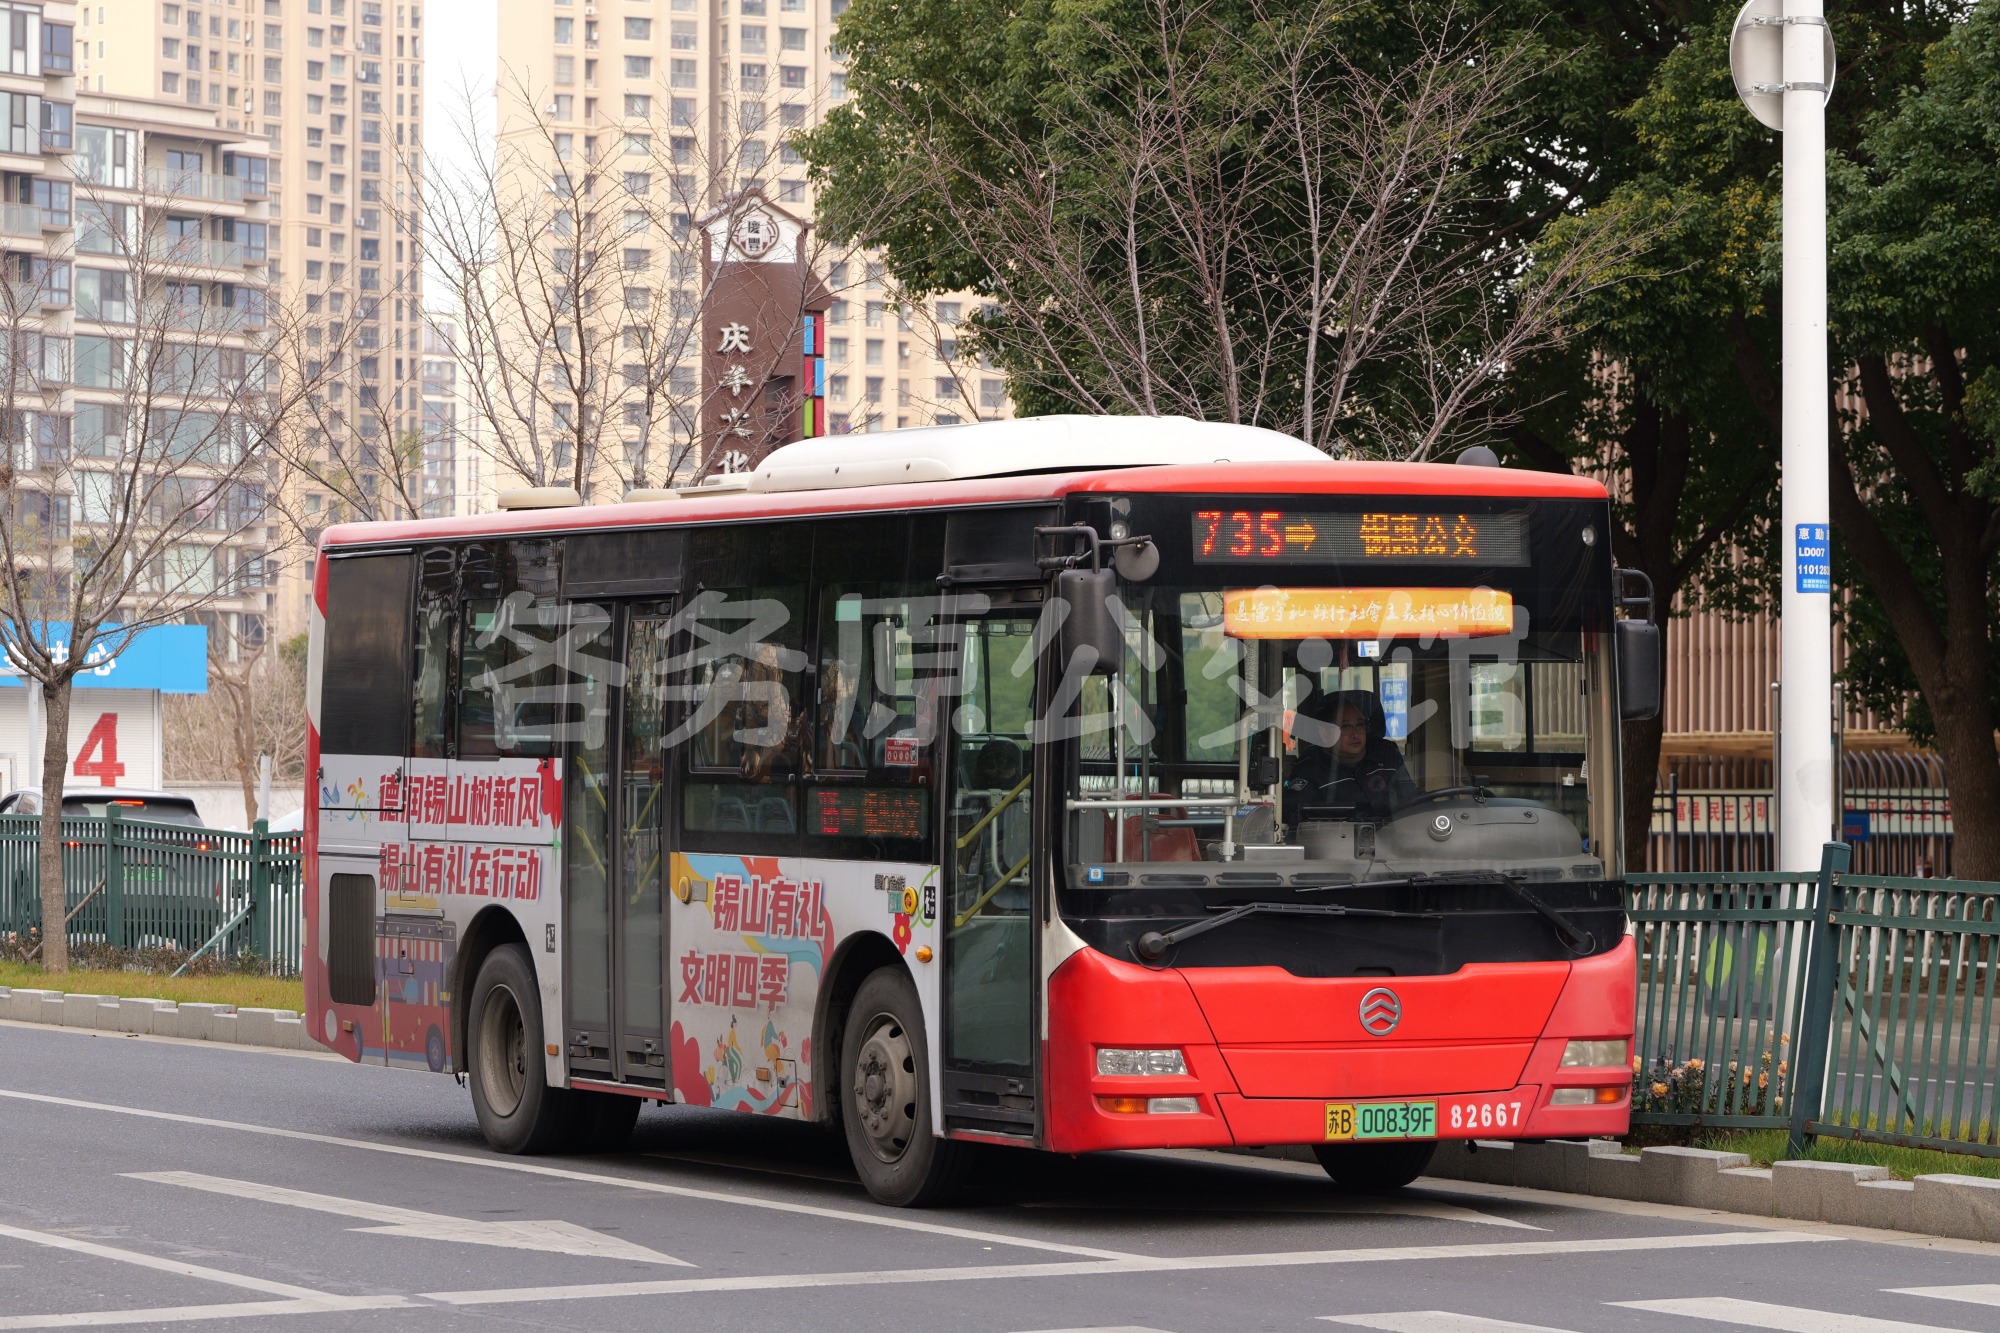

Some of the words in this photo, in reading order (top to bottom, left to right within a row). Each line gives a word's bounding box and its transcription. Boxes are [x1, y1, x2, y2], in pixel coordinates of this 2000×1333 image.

[1197, 511, 1281, 556] 735
[1798, 527, 1829, 541] 惠勤
[1798, 547, 1825, 557] LD007
[73, 712, 125, 787] 4
[379, 774, 540, 828] 德润锡山树新风
[379, 842, 540, 900] 锡山有礼在行动
[714, 877, 826, 938] 锡山有礼
[678, 950, 788, 1012] 文明四季
[1362, 1107, 1434, 1133] 00839F
[1451, 1102, 1521, 1128] 82667
